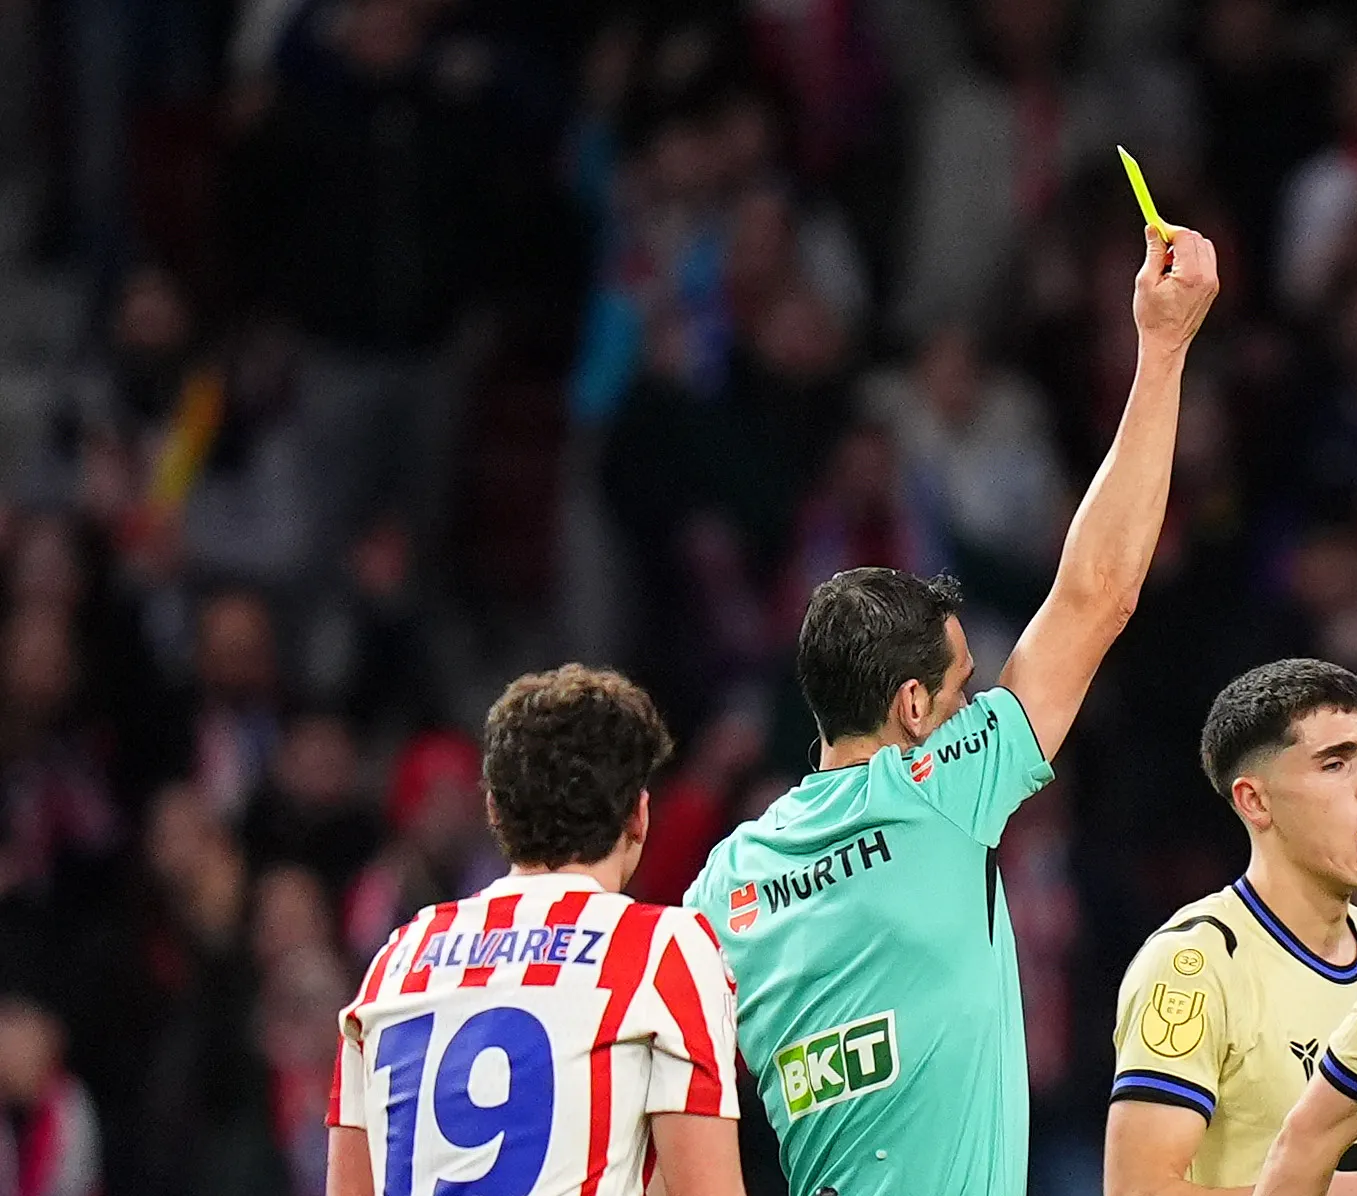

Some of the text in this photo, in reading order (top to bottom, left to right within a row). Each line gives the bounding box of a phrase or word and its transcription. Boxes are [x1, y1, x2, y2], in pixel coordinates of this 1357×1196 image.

[763, 830, 892, 914] WÜRTH
[416, 926, 605, 975] ALVAREZ
[1179, 955, 1199, 968] 32
[783, 1030, 886, 1103] BKT
